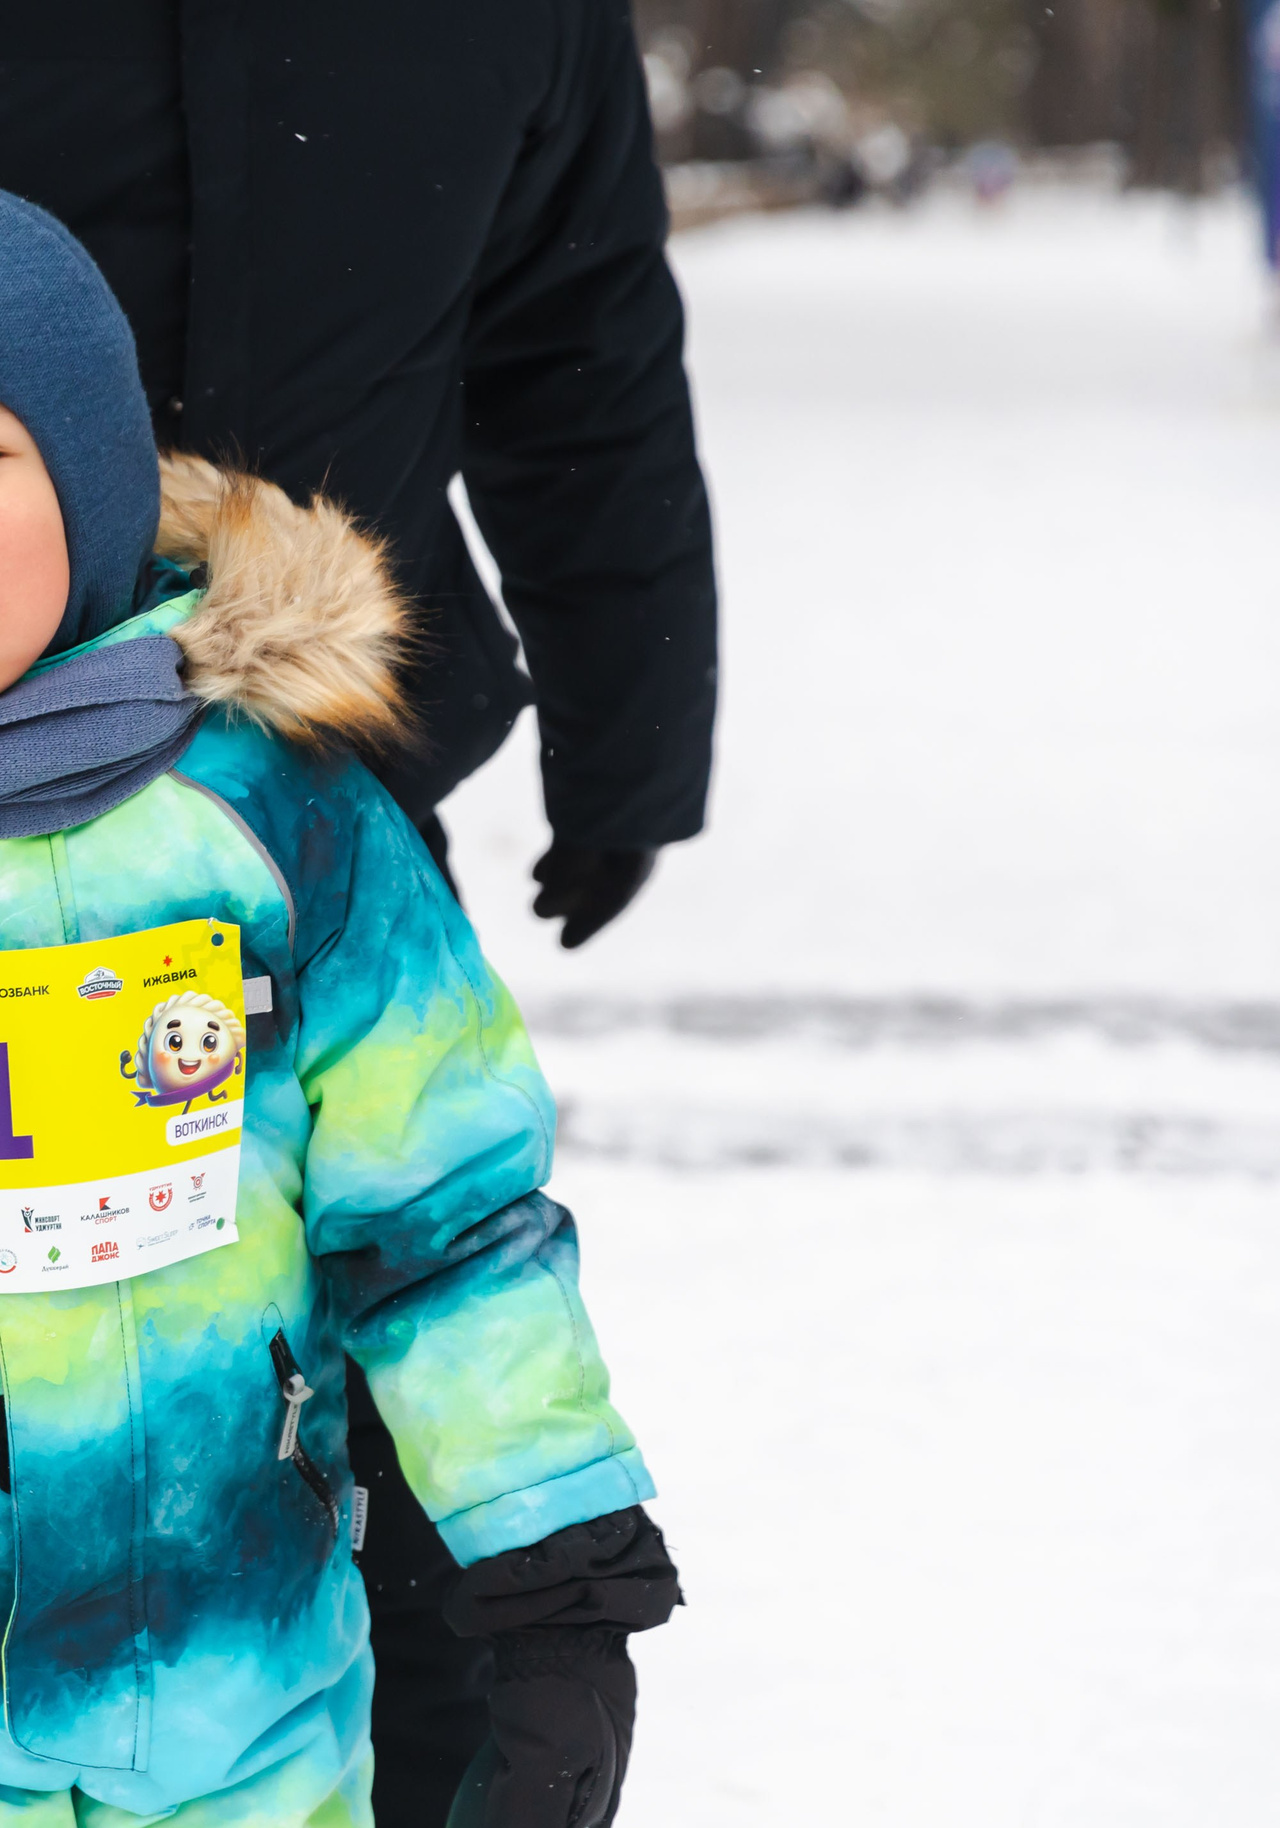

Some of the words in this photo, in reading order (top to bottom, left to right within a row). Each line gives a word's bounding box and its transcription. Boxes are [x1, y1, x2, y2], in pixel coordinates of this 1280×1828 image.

[143, 968, 197, 988] ижавиа
[79, 981, 122, 995] ВОСТОЧНЫЙ
[175, 1112, 228, 1139] ВОТКИНСК
[80, 1207, 130, 1221] КАЛАШНИКОВ
[95, 1216, 118, 1225] СПОРТ
[91, 1241, 119, 1255] ПАПА
[91, 1252, 120, 1263] ДЖОНС
